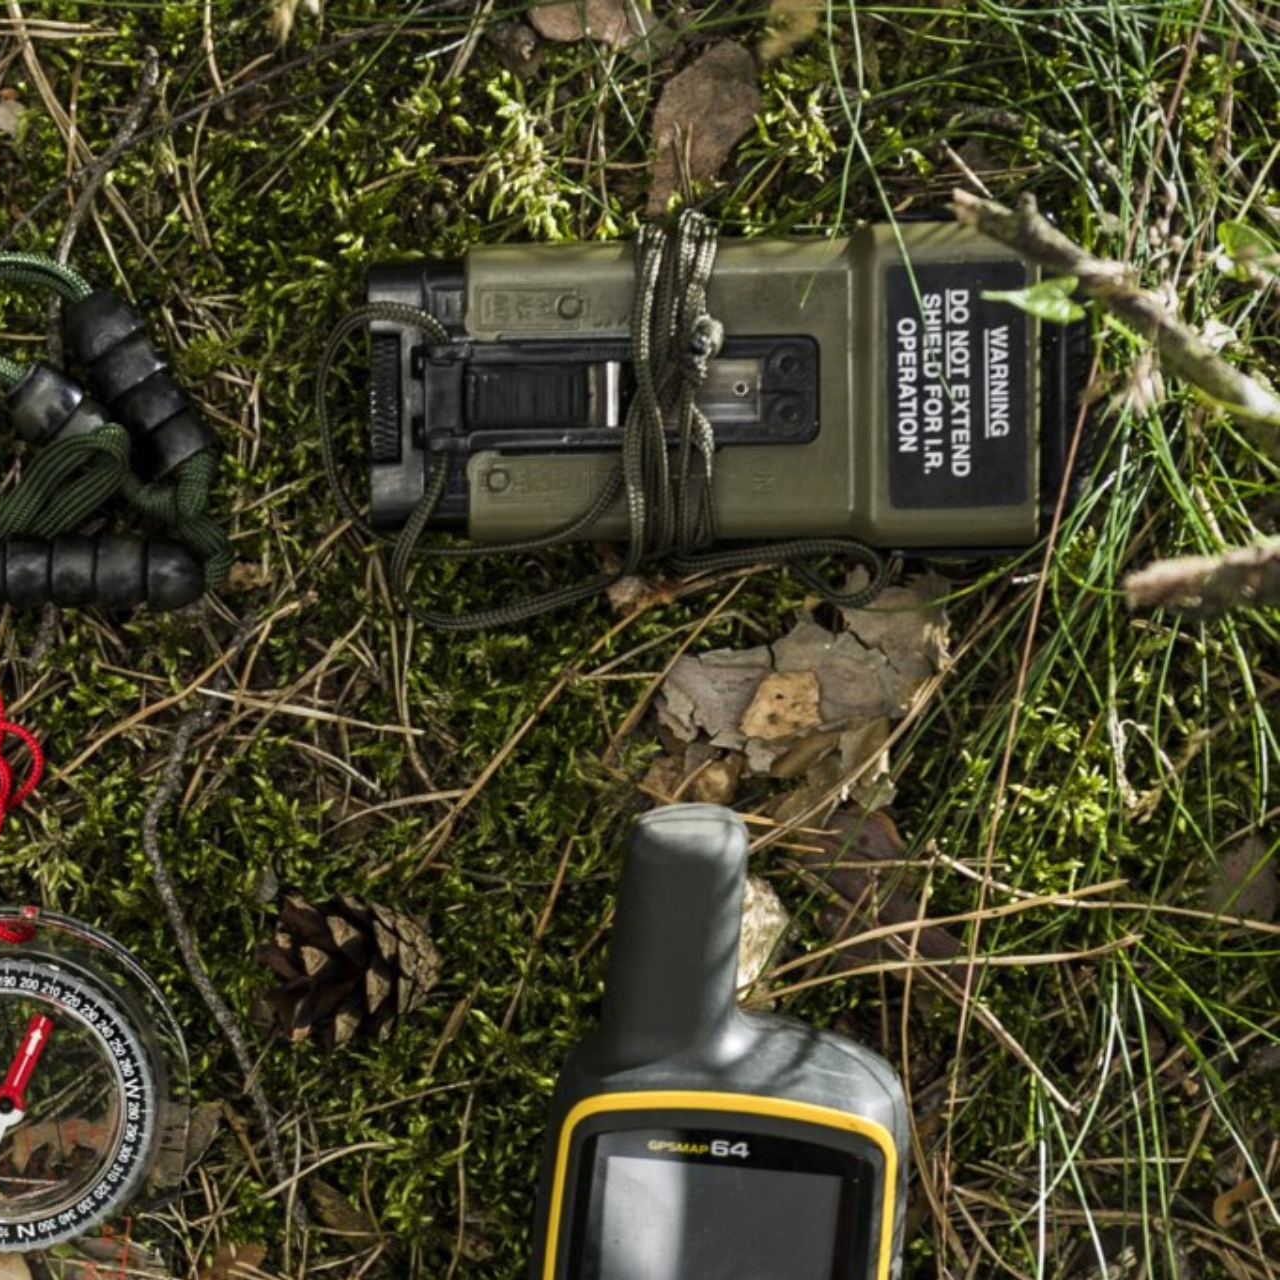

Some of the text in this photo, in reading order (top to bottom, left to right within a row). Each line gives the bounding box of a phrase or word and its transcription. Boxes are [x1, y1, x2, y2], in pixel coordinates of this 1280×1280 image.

[897, 318, 918, 452] OPERATION
[922, 294, 943, 474] SHIELD FOR I.R.
[950, 289, 971, 477] DO NOT EXTEND
[990, 326, 1009, 437] WARNING
[20, 977, 39, 990] 200
[41, 982, 61, 997] 210
[61, 991, 80, 1008] 220
[79, 1004, 98, 1021] 230
[95, 1020, 114, 1038] 240
[109, 1038, 125, 1056] 250
[124, 1078, 140, 1100] W
[118, 1144, 133, 1163] 300
[648, 1140, 749, 1158] GPSMAP 64
[107, 1164, 123, 1182] 310
[94, 1182, 111, 1199] 320
[17, 1223, 35, 1238] N
